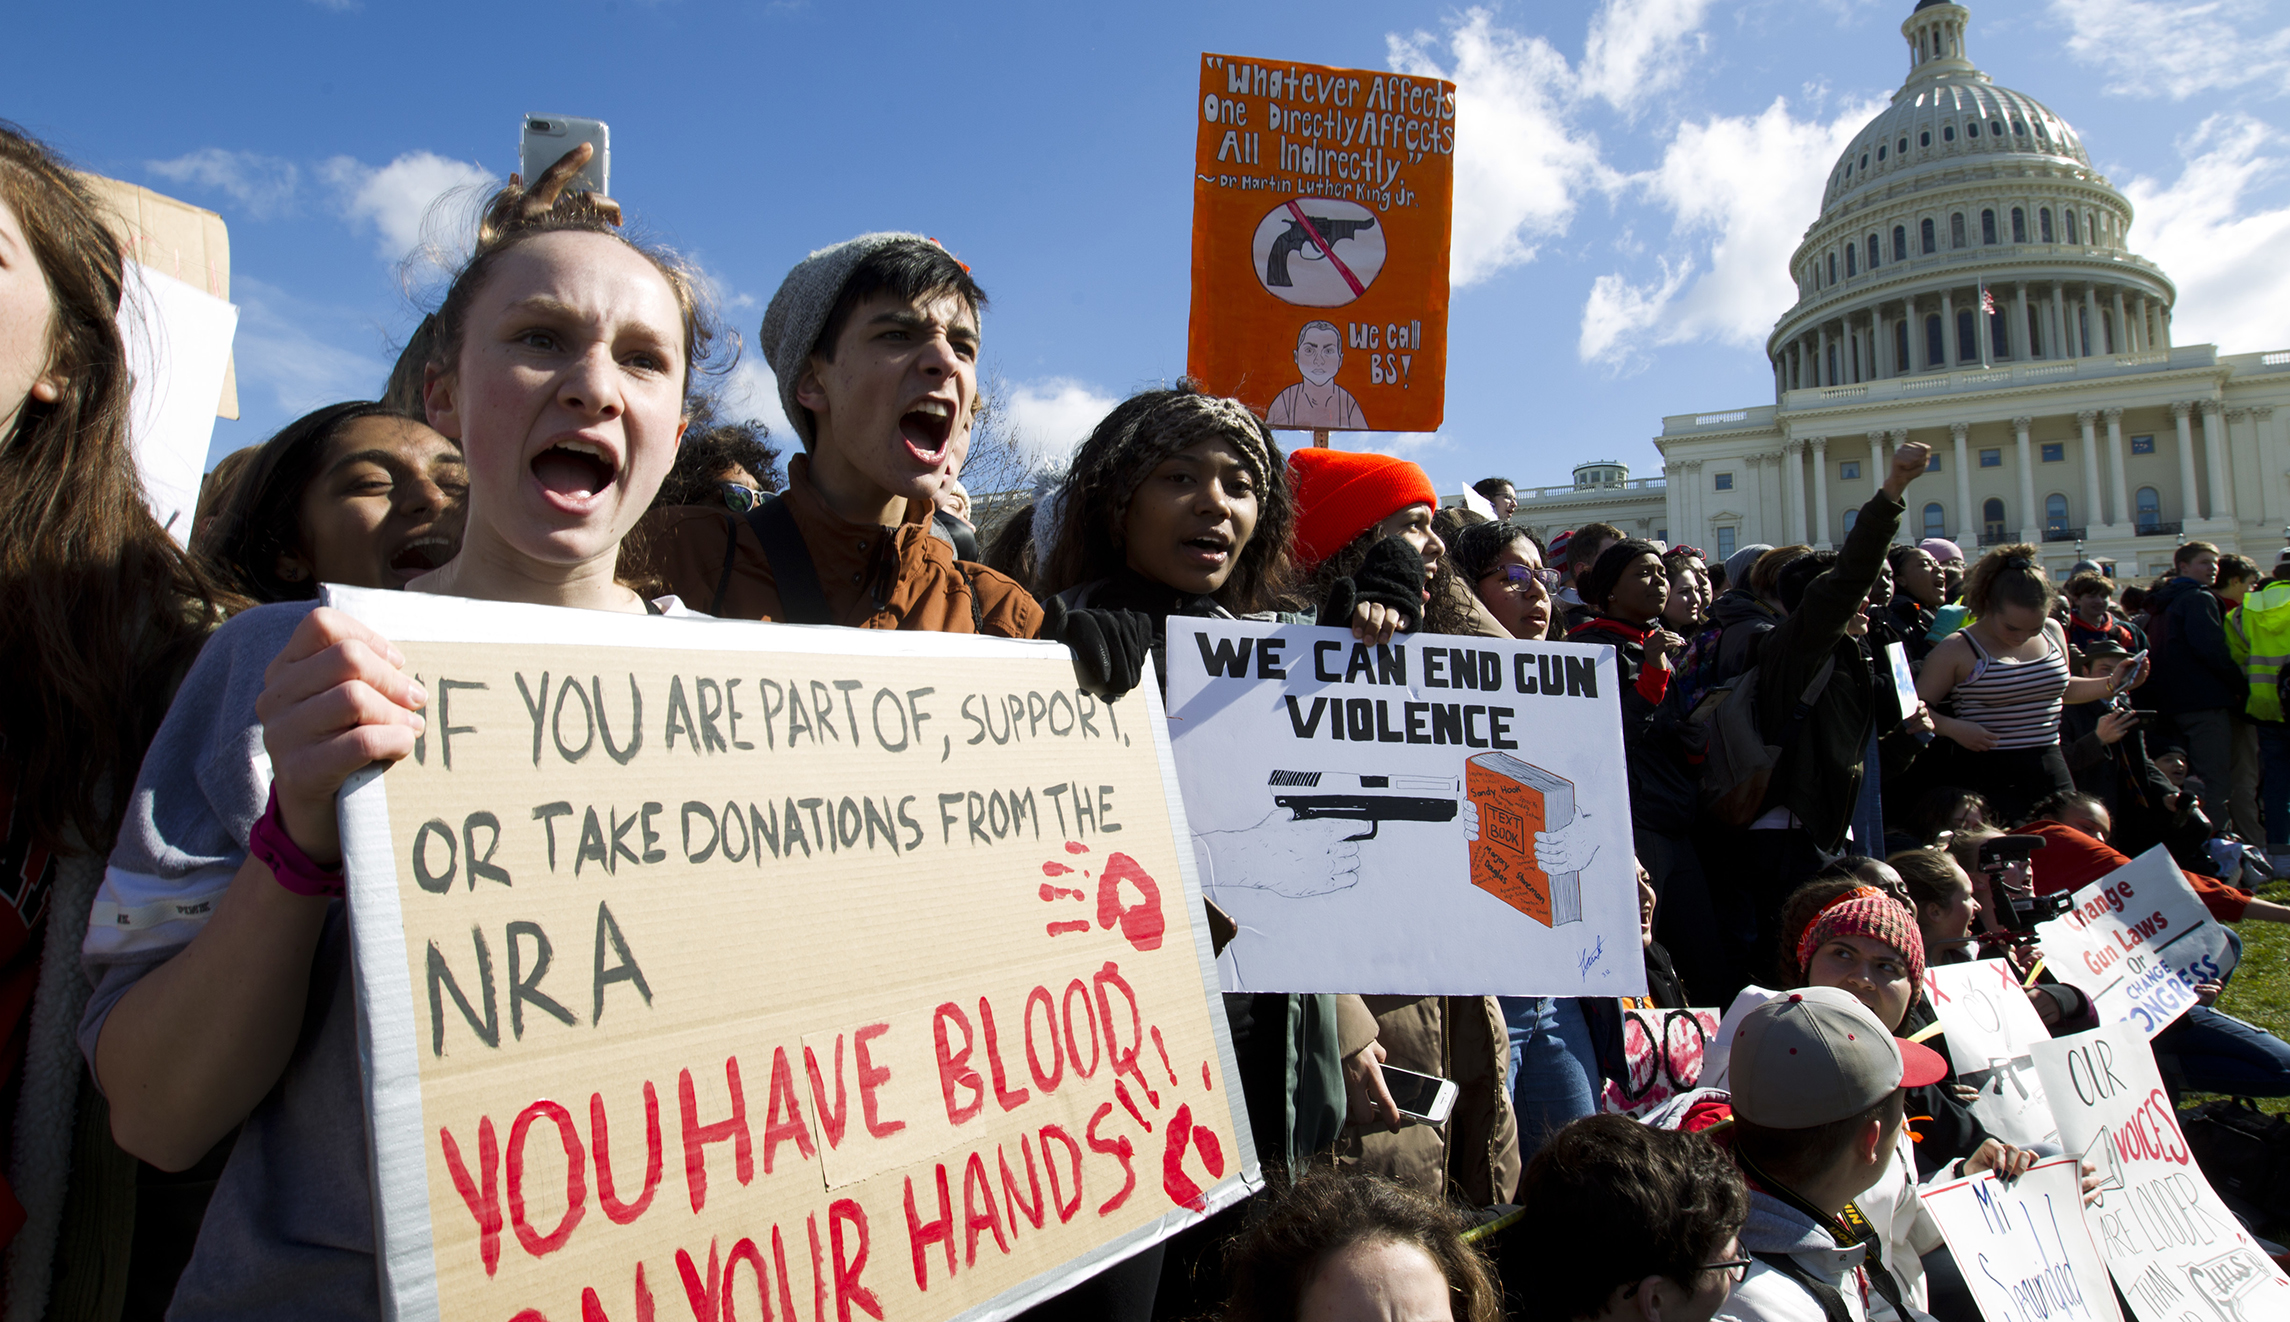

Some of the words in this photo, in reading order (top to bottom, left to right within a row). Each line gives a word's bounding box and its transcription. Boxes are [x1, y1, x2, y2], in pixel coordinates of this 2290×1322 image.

[1203, 93, 1248, 126] One
[1268, 101, 1359, 147] Directly
[1358, 111, 1454, 155] Affects
[1368, 75, 1456, 121] Affects
[1216, 130, 1259, 165] All
[1241, 174, 1291, 193] Martin
[1297, 178, 1352, 198] Luther
[1355, 183, 1390, 212] King
[1348, 321, 1379, 351] We
[1370, 353, 1413, 390] BS!
[1194, 631, 1287, 680] WE
[1313, 640, 1408, 687] CAN
[1422, 646, 1502, 692] END
[1513, 652, 1599, 698] GUN
[415, 672, 490, 771] IF
[514, 670, 644, 771] YOU
[665, 674, 755, 757] ARE
[759, 676, 864, 751] PART
[1284, 694, 1519, 750] VIOLENCE
[1470, 787, 1498, 799] Sandy
[1500, 785, 1522, 794] Hook
[1488, 807, 1522, 830] TEXT
[412, 810, 512, 895] OR
[531, 801, 667, 879] TAKE
[680, 795, 925, 868] DONATIONS
[938, 786, 1040, 847] FROM
[1043, 780, 1123, 839] THE
[1489, 824, 1520, 847] BOOK
[1484, 859, 1509, 885] Douglas
[2063, 880, 2135, 932] Change
[2082, 944, 2121, 976] Gun
[2112, 911, 2169, 953] Laws
[2126, 954, 2148, 975] Or
[426, 900, 655, 1058] NRA
[2119, 954, 2220, 1033] ONGRESS
[2126, 959, 2172, 1000] CHANGE
[2067, 1039, 2128, 1107] OUR
[439, 1079, 664, 1280] YOU
[678, 1022, 907, 1215] HAVE
[2113, 1088, 2189, 1166] VOICES
[1972, 1179, 2012, 1235] Mi
[2099, 1208, 2143, 1260] ARE
[2123, 1172, 2232, 1252] LOUDER
[675, 1197, 887, 1322] YOUR
[2127, 1260, 2185, 1320] THAN
